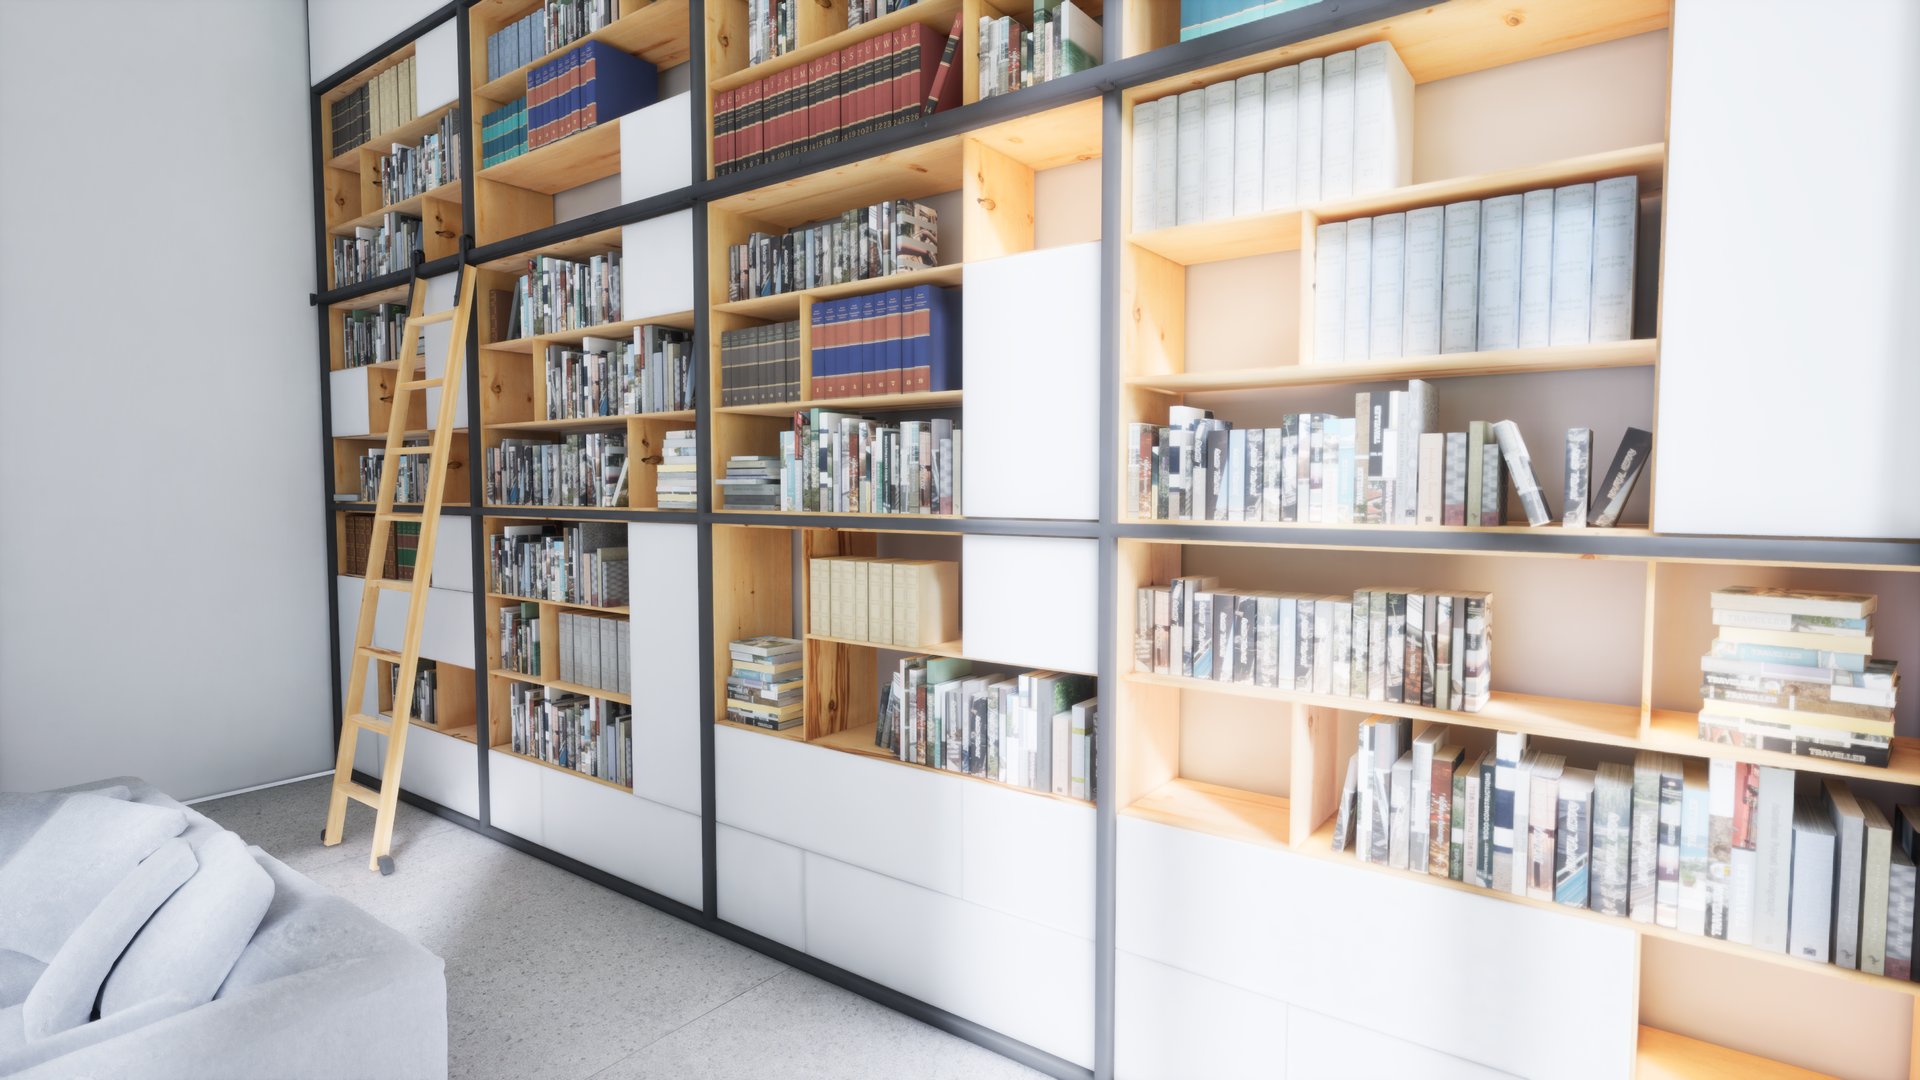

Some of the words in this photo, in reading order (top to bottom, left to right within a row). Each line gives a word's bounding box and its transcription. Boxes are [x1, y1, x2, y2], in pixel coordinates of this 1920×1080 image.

[953, 20, 961, 29] N
[924, 106, 932, 114] 14
[1808, 747, 1866, 763] TRAVELLER
